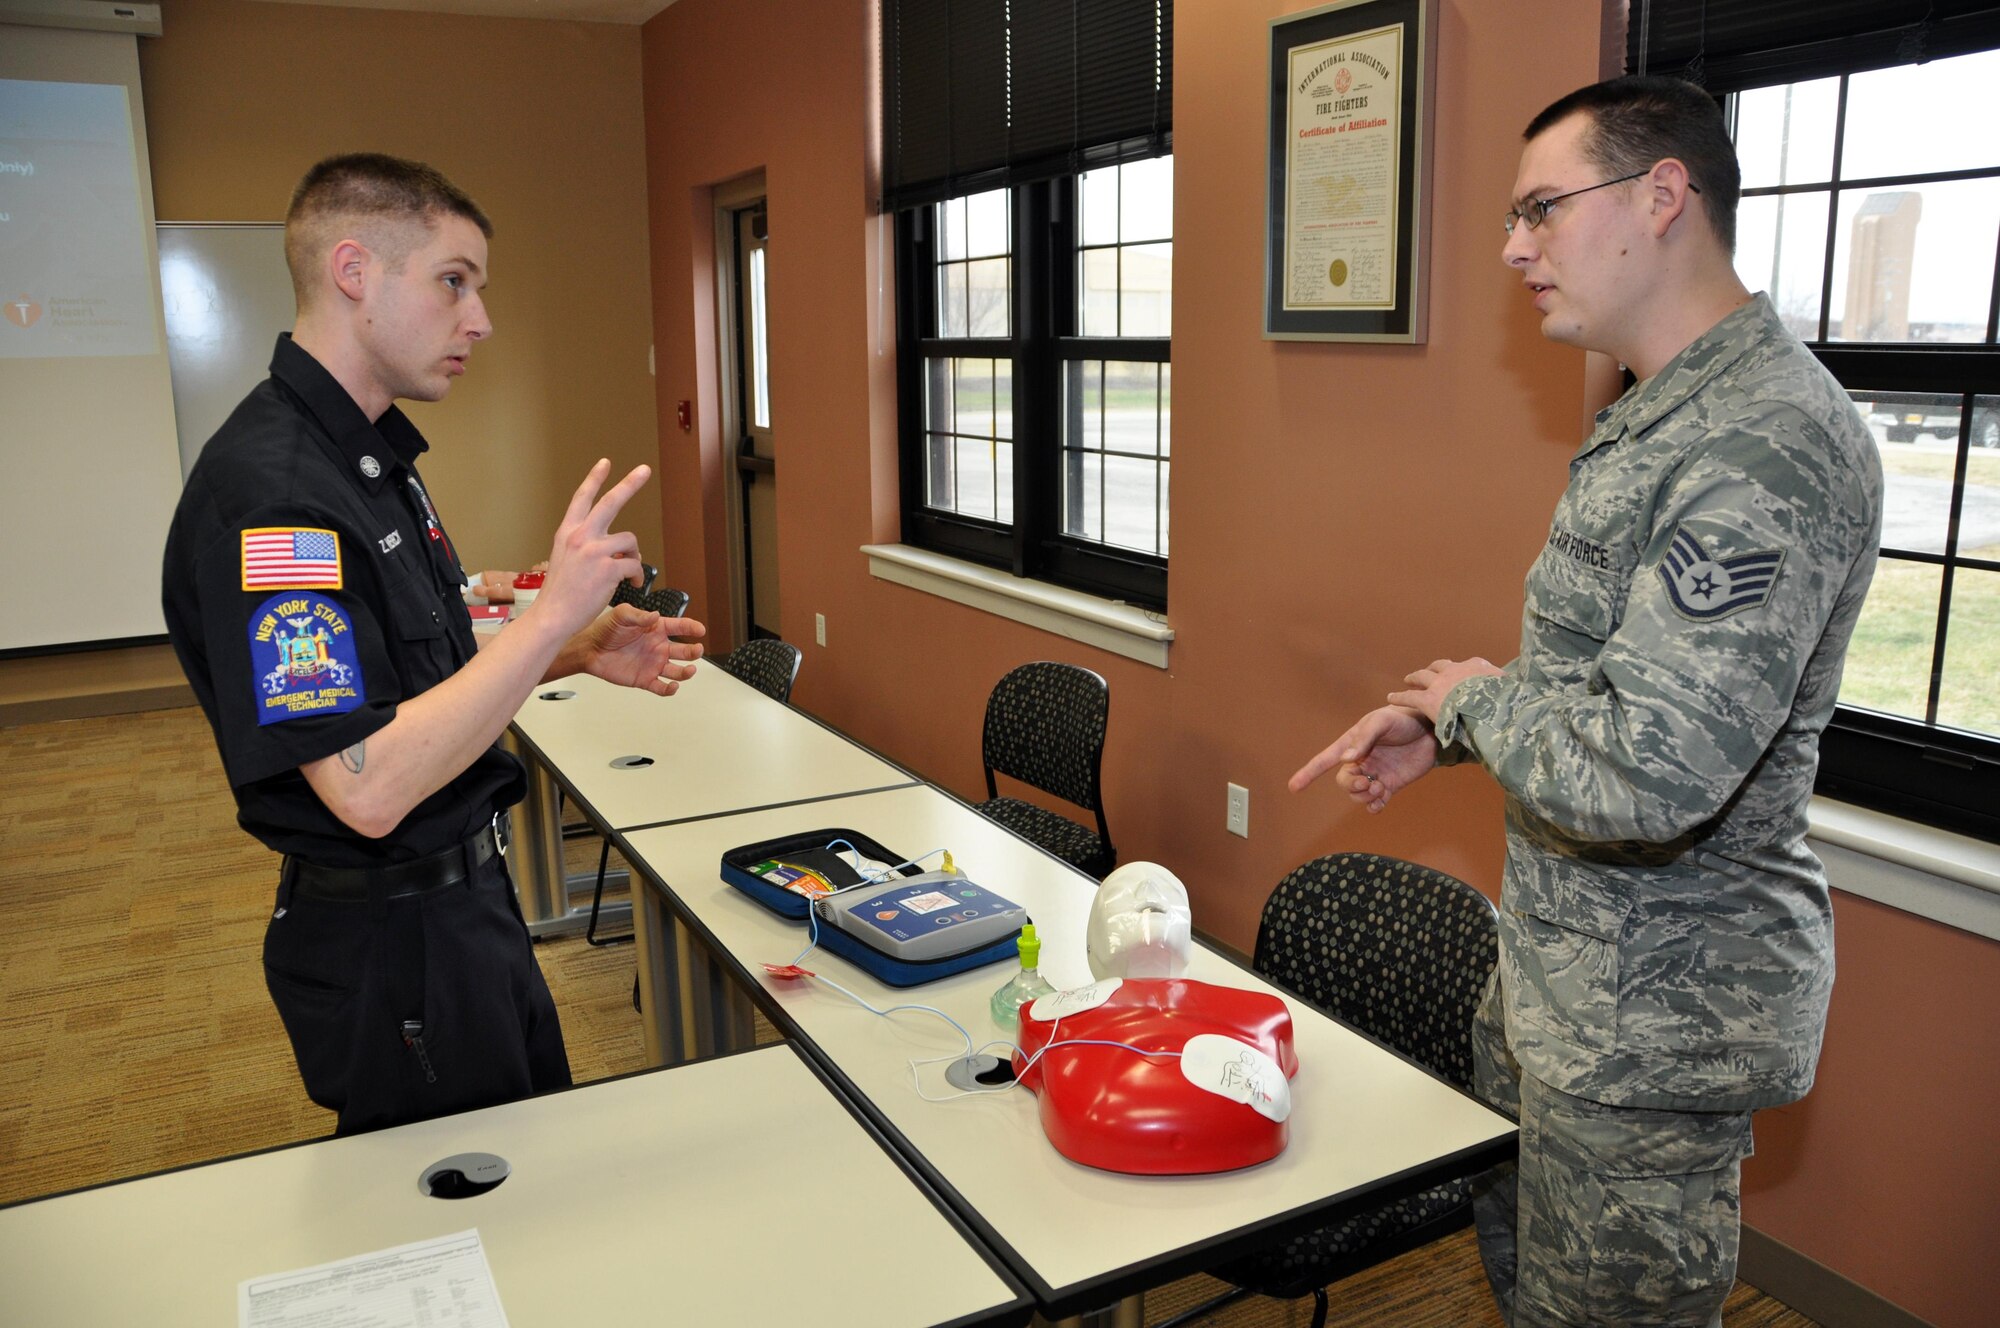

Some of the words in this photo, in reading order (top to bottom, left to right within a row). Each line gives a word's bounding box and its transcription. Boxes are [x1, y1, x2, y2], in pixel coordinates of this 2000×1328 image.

[1298, 52, 1346, 94] INTERNATIONAL
[1350, 51, 1390, 81] ASSOCIATION
[1316, 102, 1332, 115] FIRE
[1335, 96, 1368, 112] FIGHTERS
[1299, 124, 1336, 138] Certificate
[1338, 122, 1346, 134] of
[1347, 118, 1388, 132] Affiliation
[1555, 530, 1570, 553] AIR
[1568, 537, 1608, 569] FORCE
[255, 614, 279, 642] NEW
[273, 599, 310, 618] YORK
[313, 602, 348, 636] STATE
[265, 691, 316, 708] EMERGENCY
[319, 688, 357, 703] MEDICAL
[287, 698, 336, 712] TECHNICIAN
